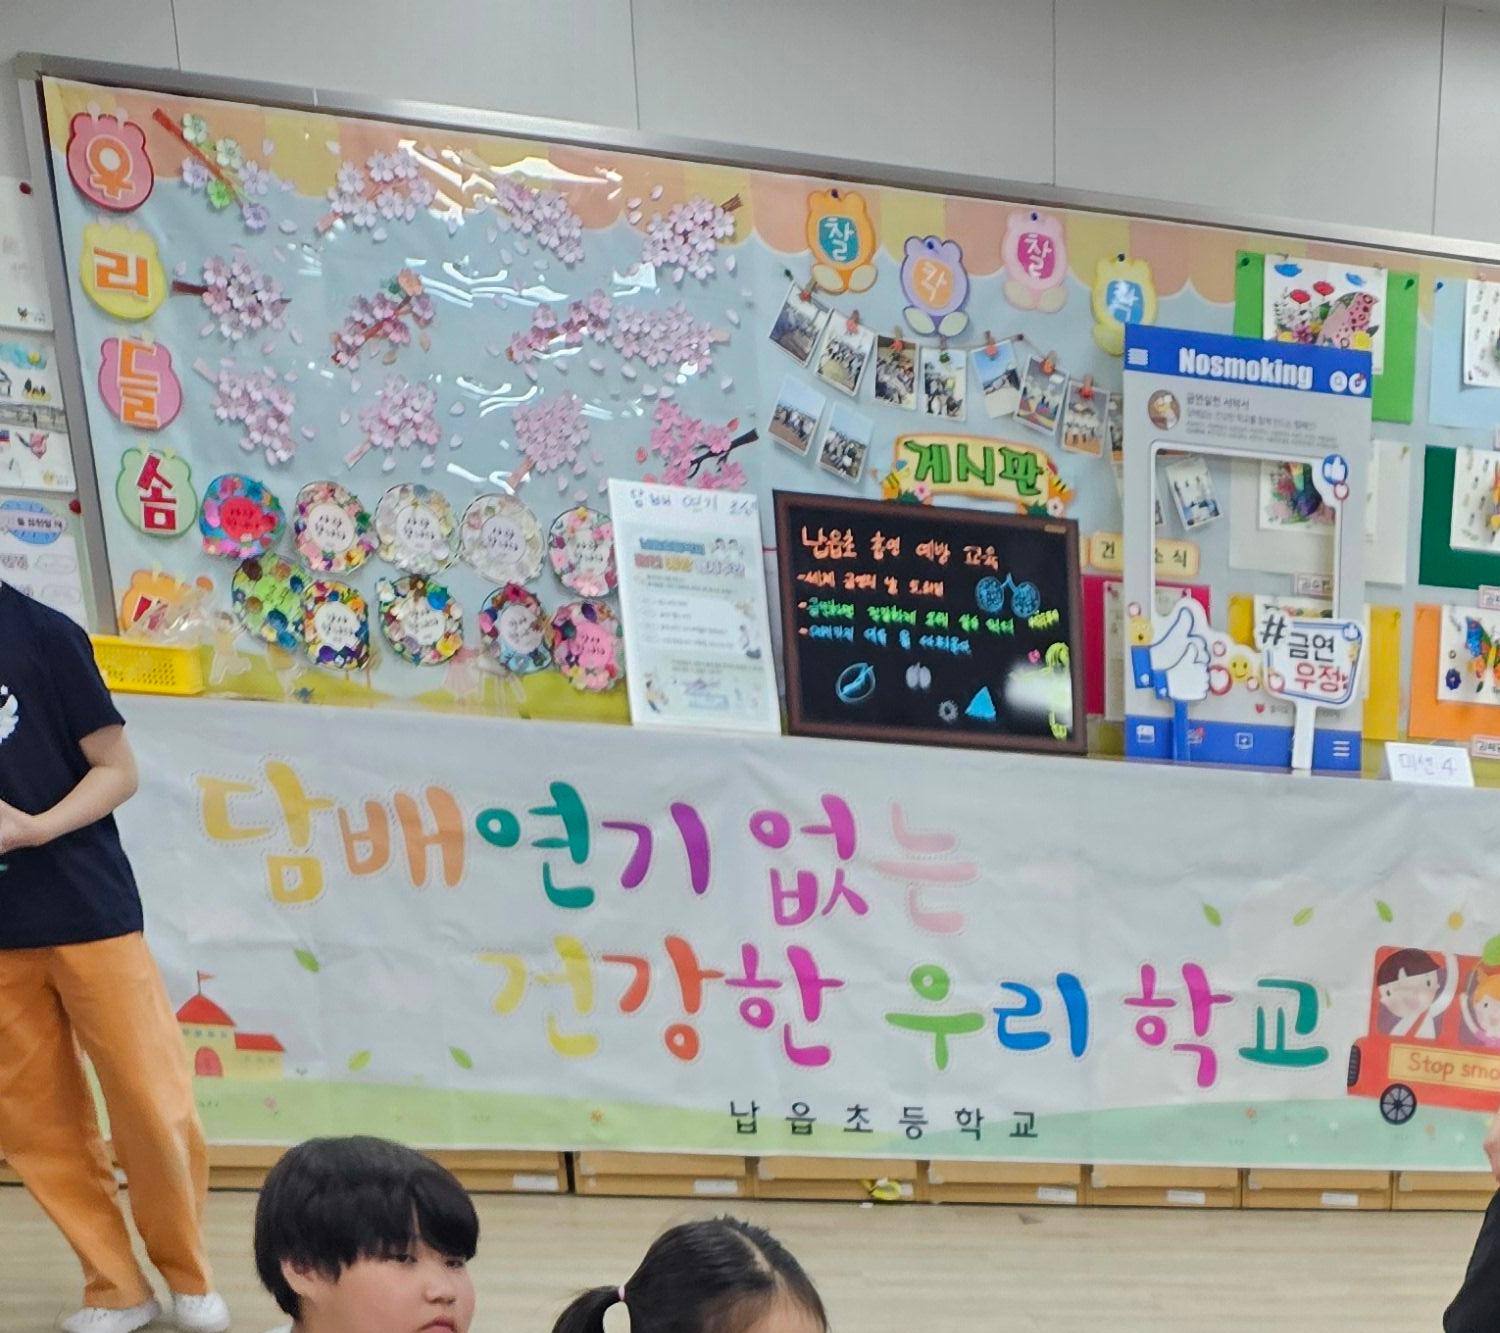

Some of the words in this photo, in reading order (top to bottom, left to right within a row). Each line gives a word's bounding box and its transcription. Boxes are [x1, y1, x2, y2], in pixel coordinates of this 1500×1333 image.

[1178, 347, 1314, 391] Nosmoking
[904, 440, 1044, 496] 게시판
[1441, 756, 1458, 776] 4
[196, 760, 711, 909] 담배연기
[749, 793, 978, 934] 없는
[476, 934, 845, 1067] 건강한
[885, 963, 1089, 1071] 우리
[1124, 962, 1329, 1088] 학교
[1407, 1051, 1455, 1081] Stop
[729, 1100, 1039, 1141] 납읍초등학교
